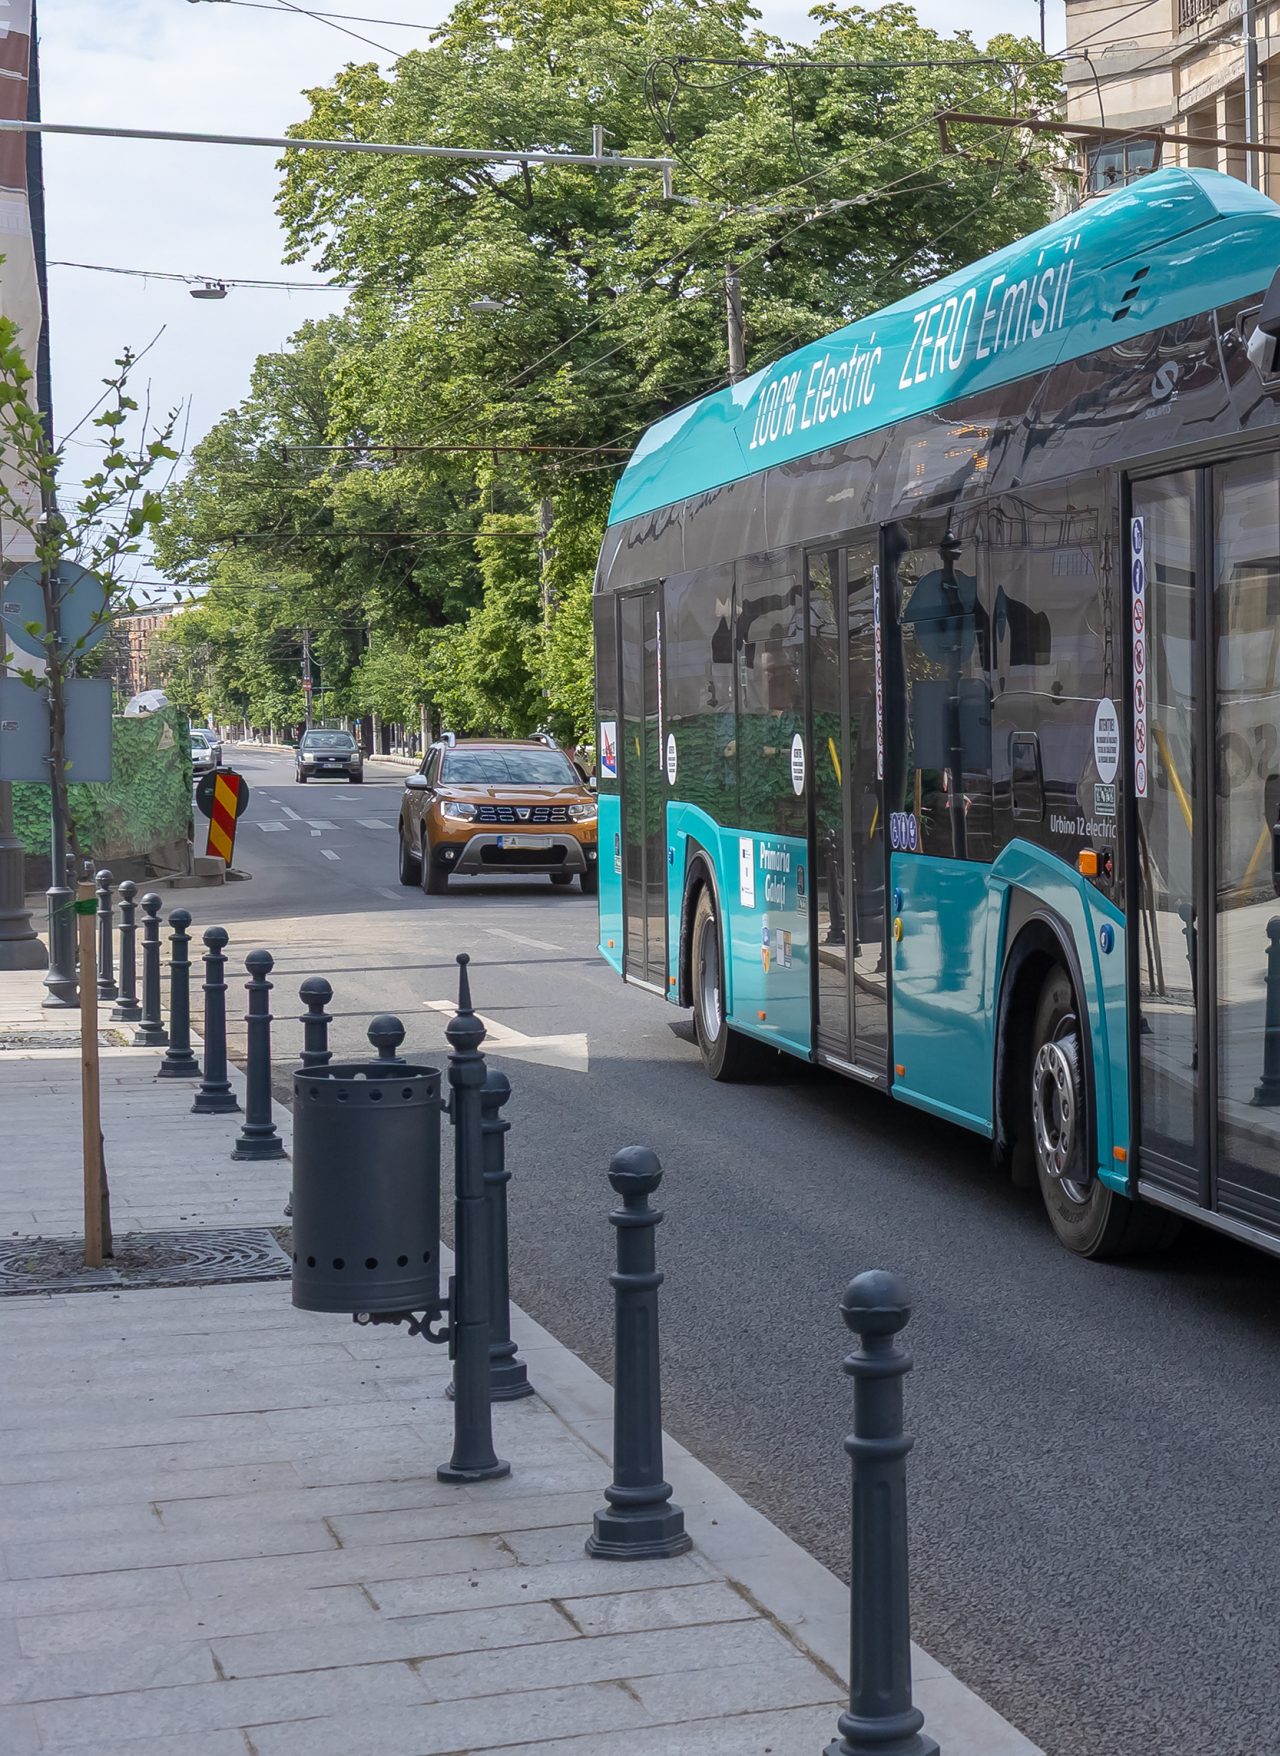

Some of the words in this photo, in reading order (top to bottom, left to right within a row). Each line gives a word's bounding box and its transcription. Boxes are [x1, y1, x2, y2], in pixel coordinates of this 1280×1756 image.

[749, 369, 802, 449] 100%
[800, 332, 882, 429] Electric
[899, 287, 976, 390] ZERO
[975, 234, 1081, 360] Emisii
[1050, 814, 1075, 835] Urbino
[1076, 816, 1085, 836] 12
[1085, 818, 1117, 839] electric
